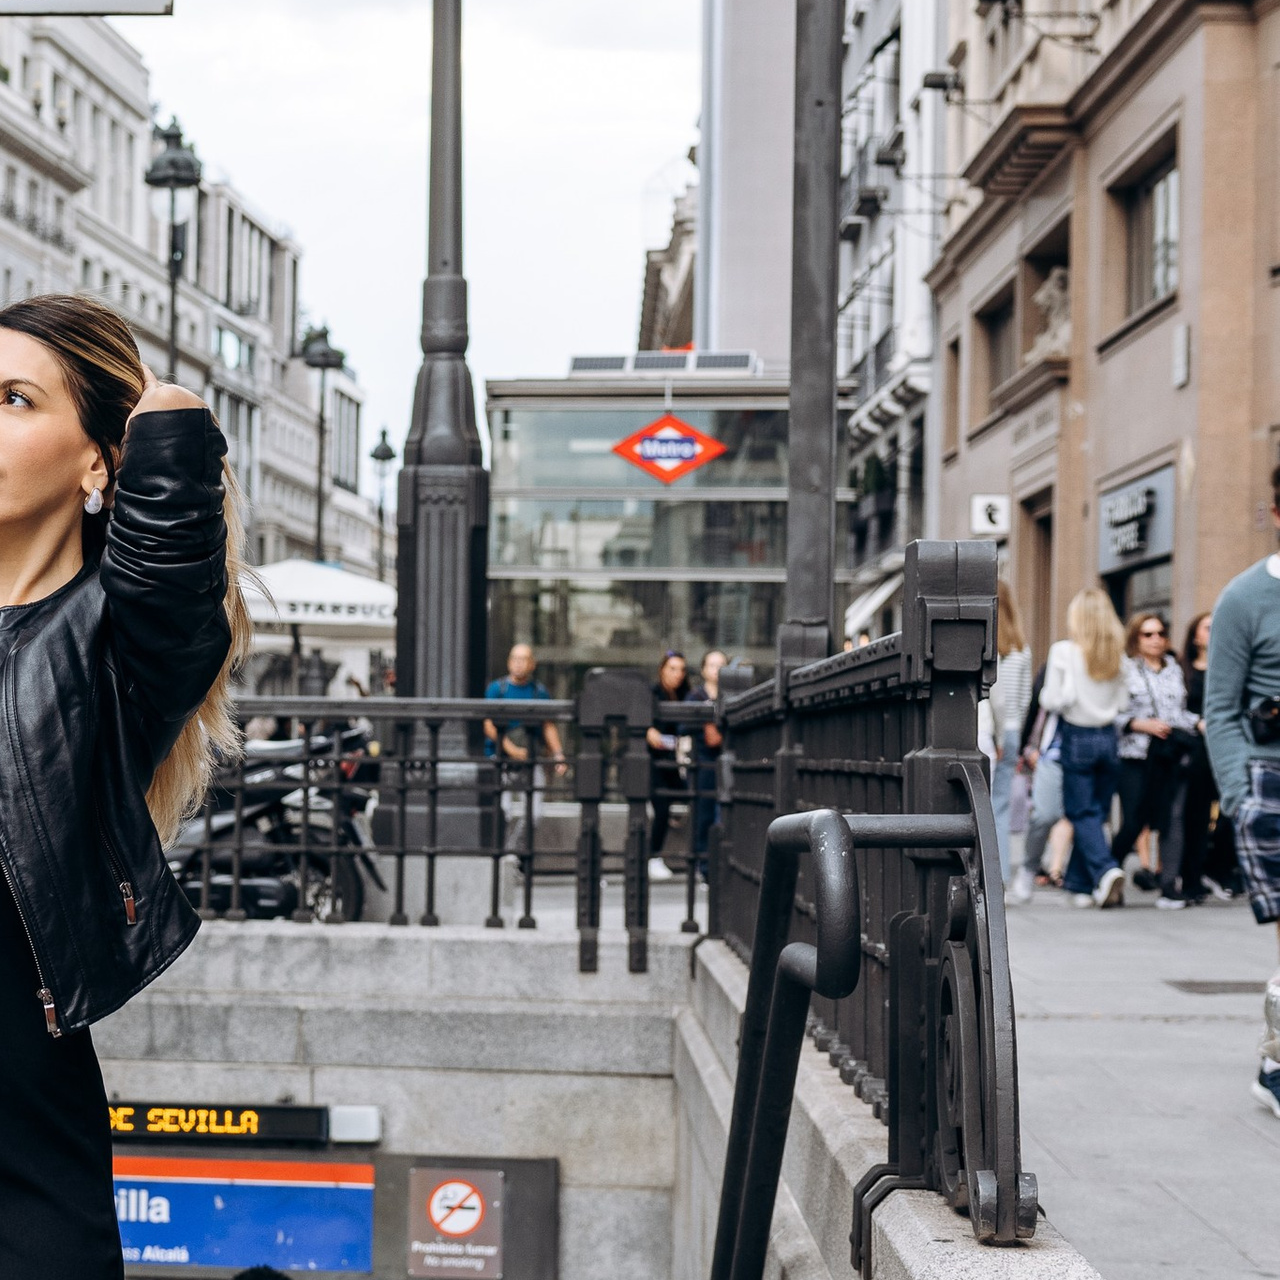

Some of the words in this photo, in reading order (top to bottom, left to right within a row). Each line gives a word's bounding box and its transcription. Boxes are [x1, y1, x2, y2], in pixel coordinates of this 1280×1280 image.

[642, 439, 694, 458] Metro
[288, 601, 397, 619] STARBUC
[147, 1108, 259, 1134] SEVILLA
[114, 1187, 171, 1224] illa
